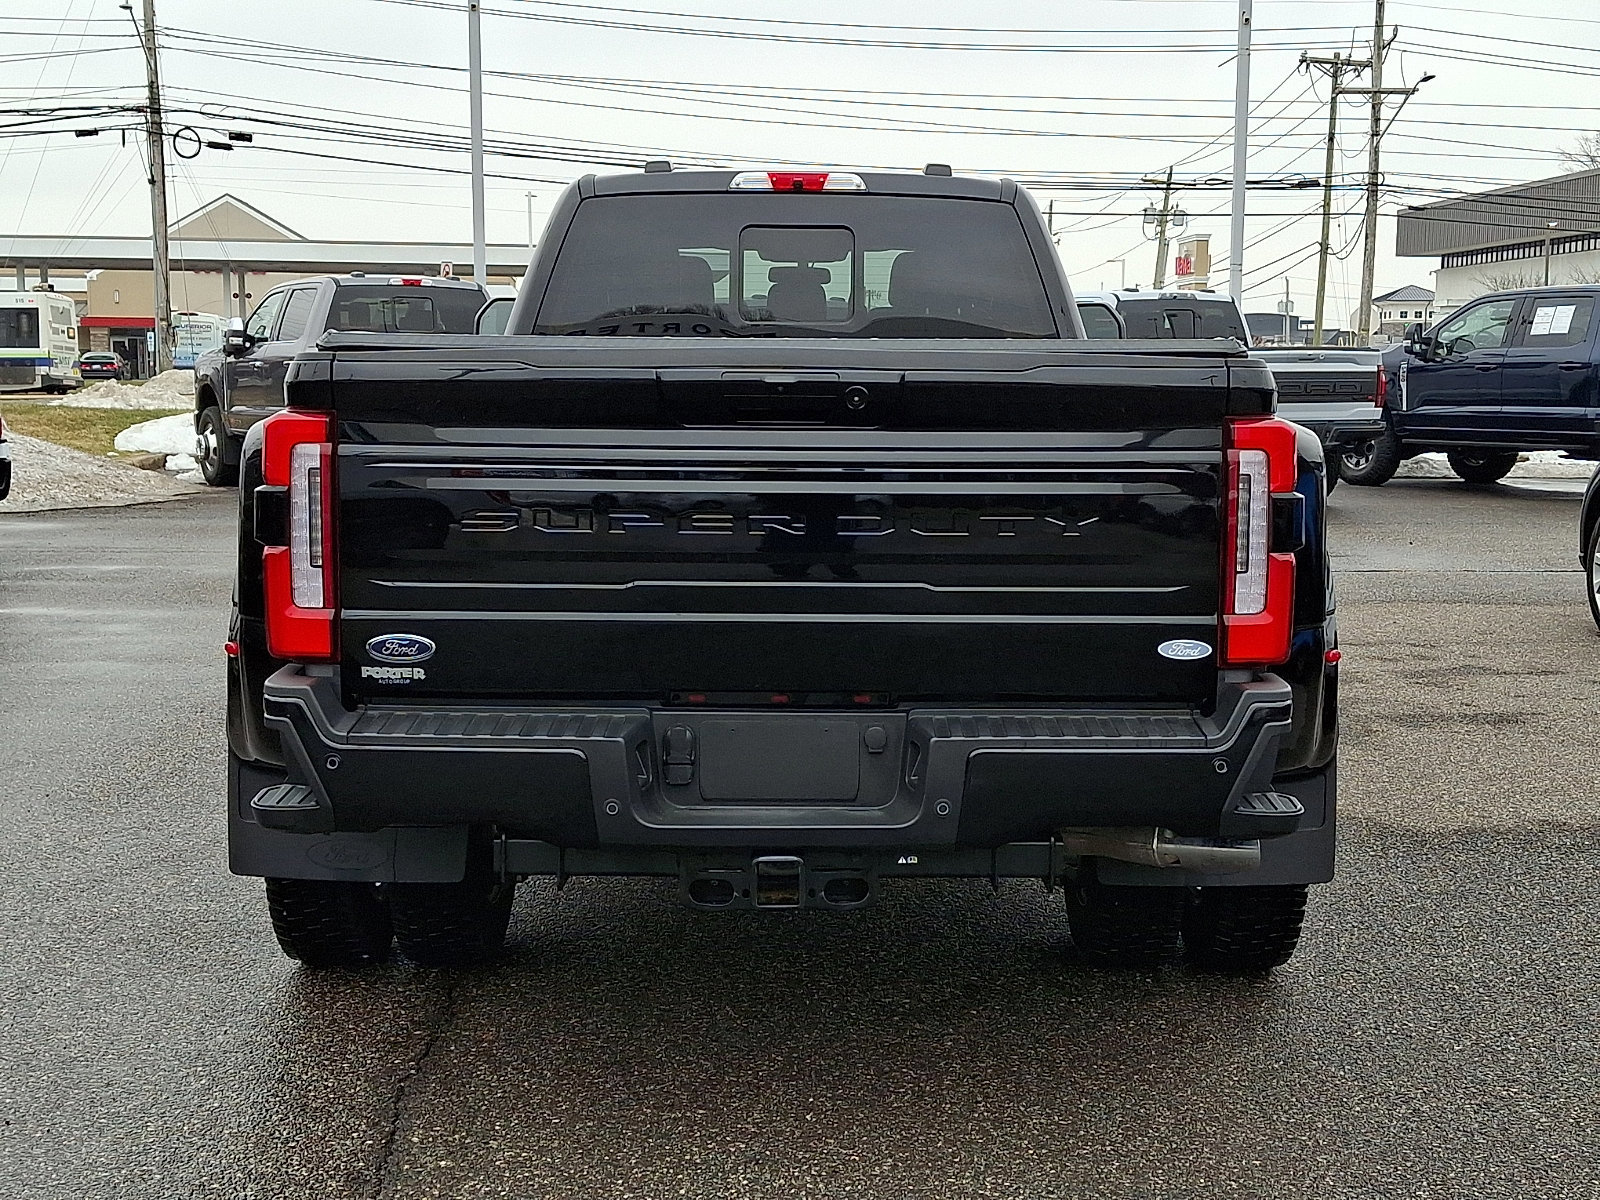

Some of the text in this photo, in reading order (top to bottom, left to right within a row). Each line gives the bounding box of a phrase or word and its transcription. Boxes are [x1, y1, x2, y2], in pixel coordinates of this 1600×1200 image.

[1277, 382, 1363, 394] ORD
[460, 508, 1100, 537] SUPER DUTY
[361, 666, 426, 680] PORTER
